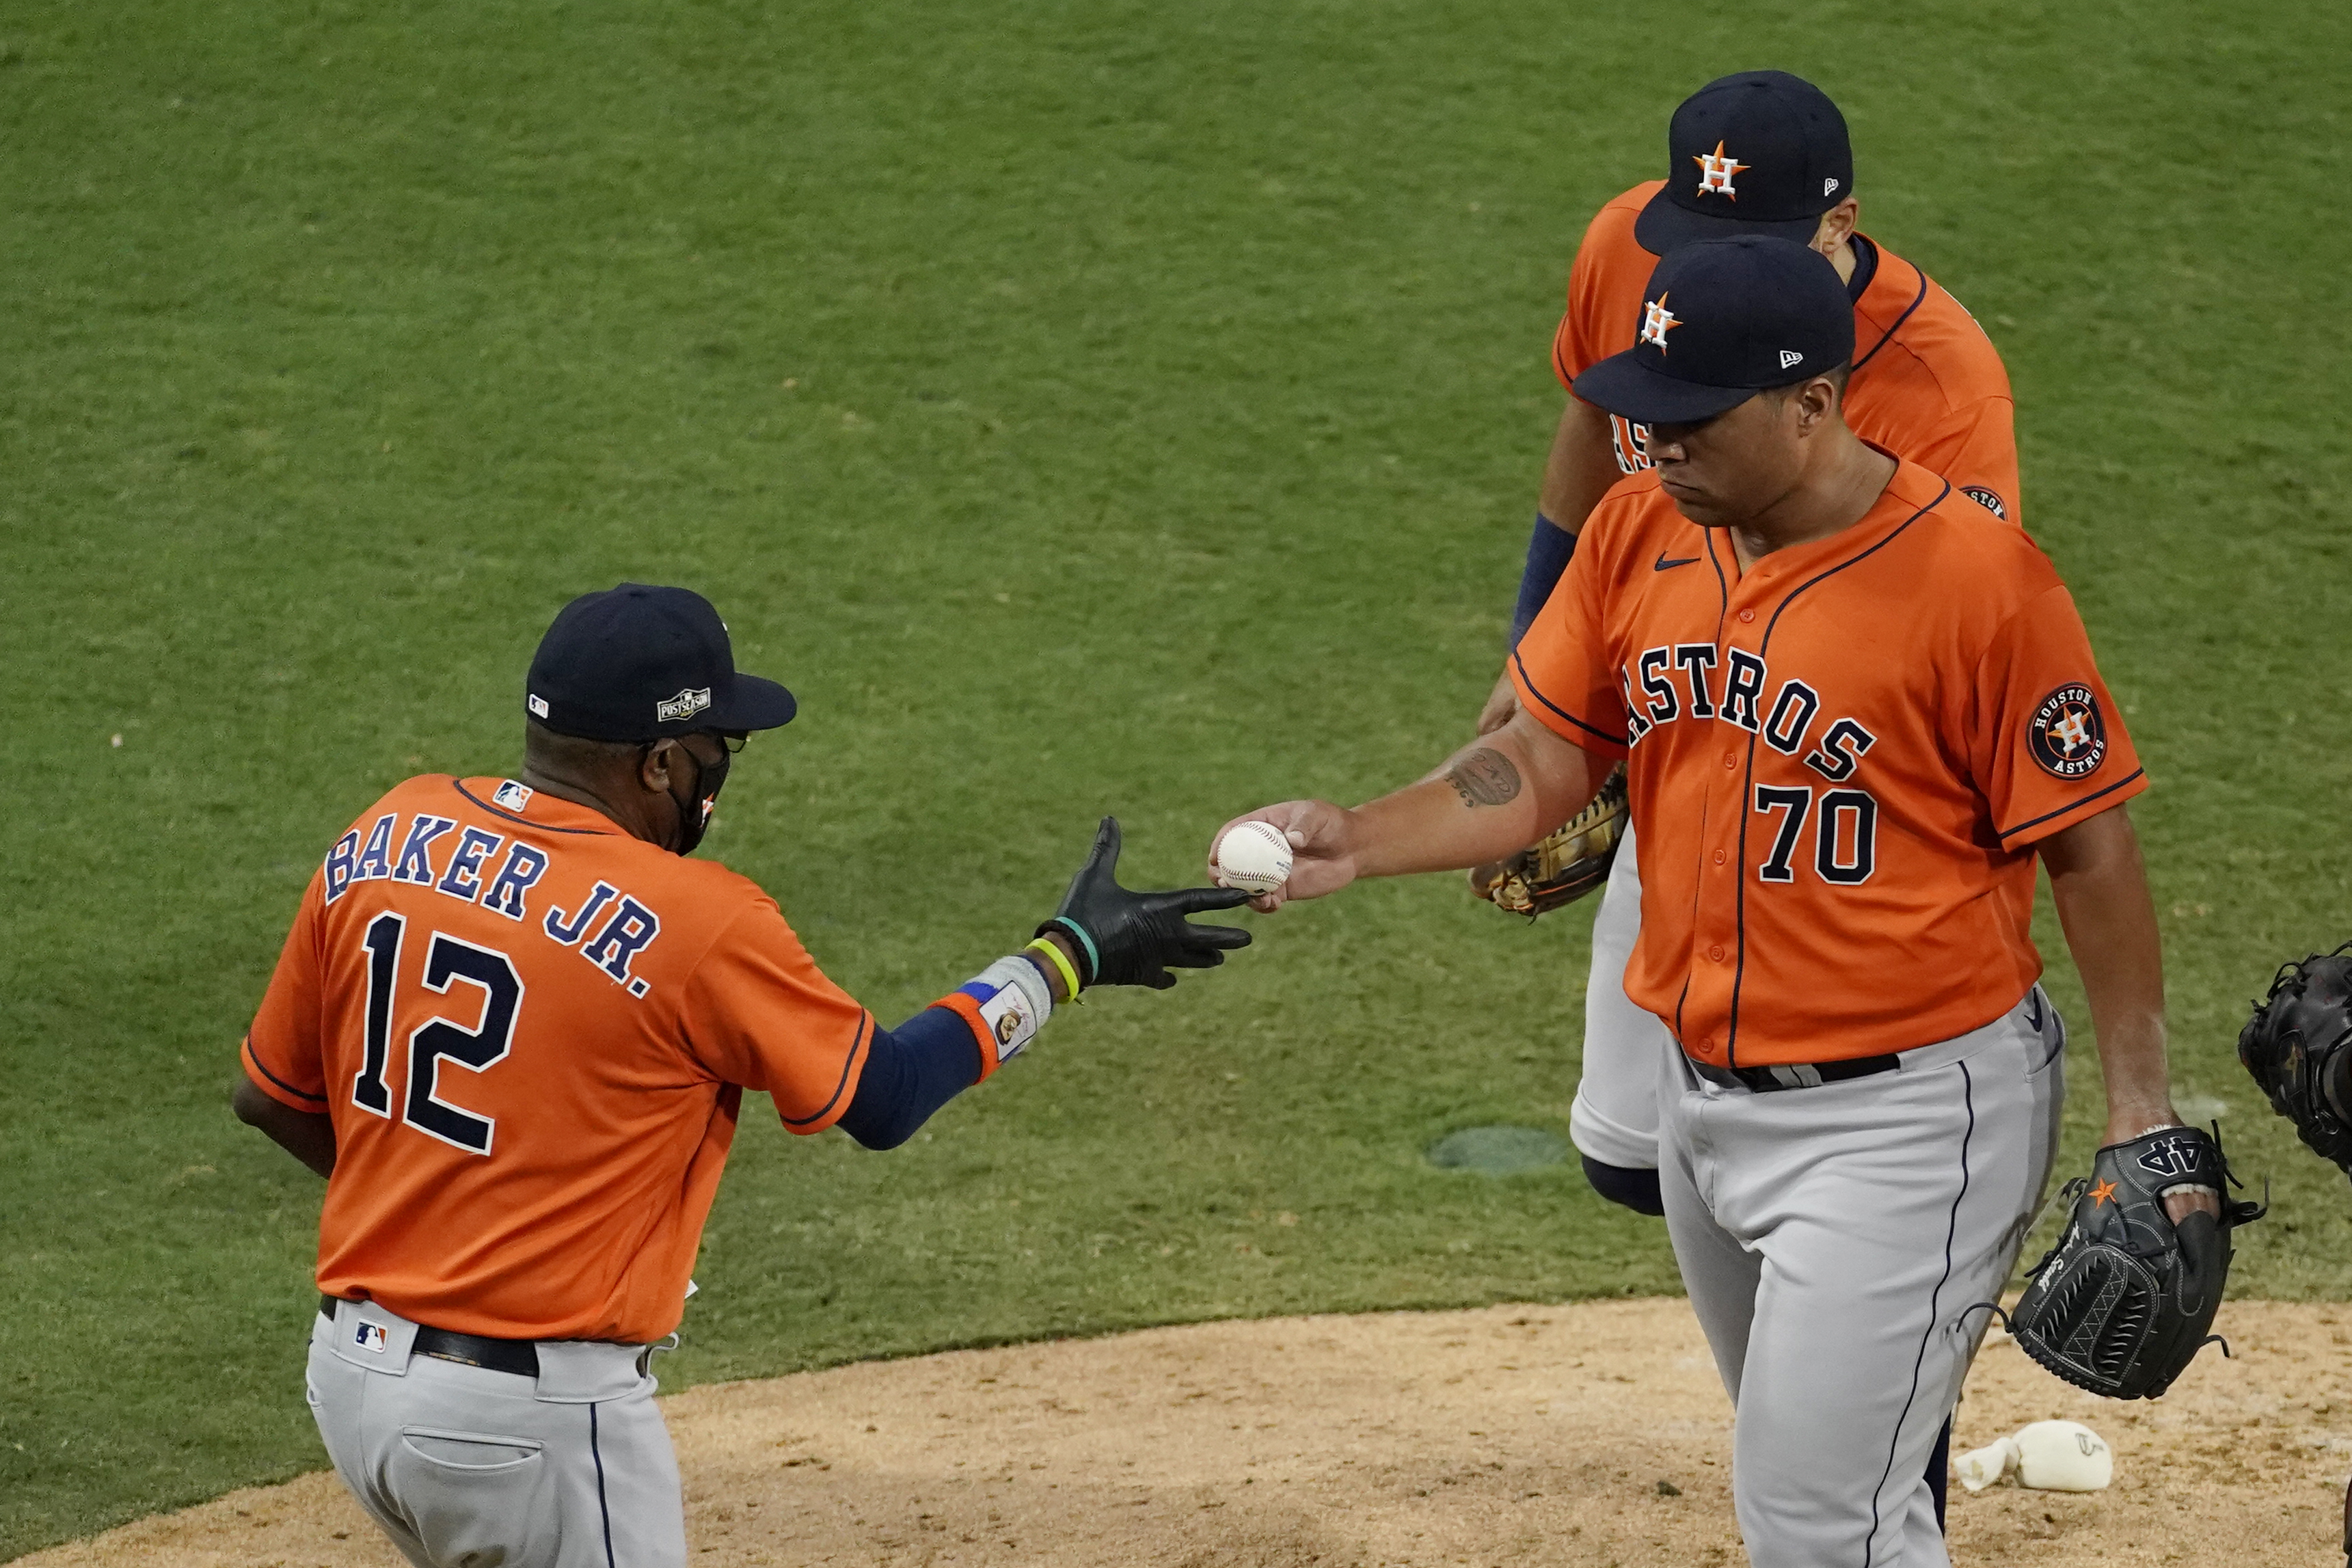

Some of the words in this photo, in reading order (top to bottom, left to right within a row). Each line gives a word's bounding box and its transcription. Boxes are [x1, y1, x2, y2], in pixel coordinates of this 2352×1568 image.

[1969, 491, 2003, 517] STON
[2034, 689, 2092, 729] HOUSTON
[2054, 740, 2104, 773] ASTROS
[1755, 783, 1878, 885] 70
[324, 813, 550, 923] BAKER
[542, 880, 661, 999] JR.
[351, 910, 526, 1157] 12
[2136, 1135, 2202, 1177] 44
